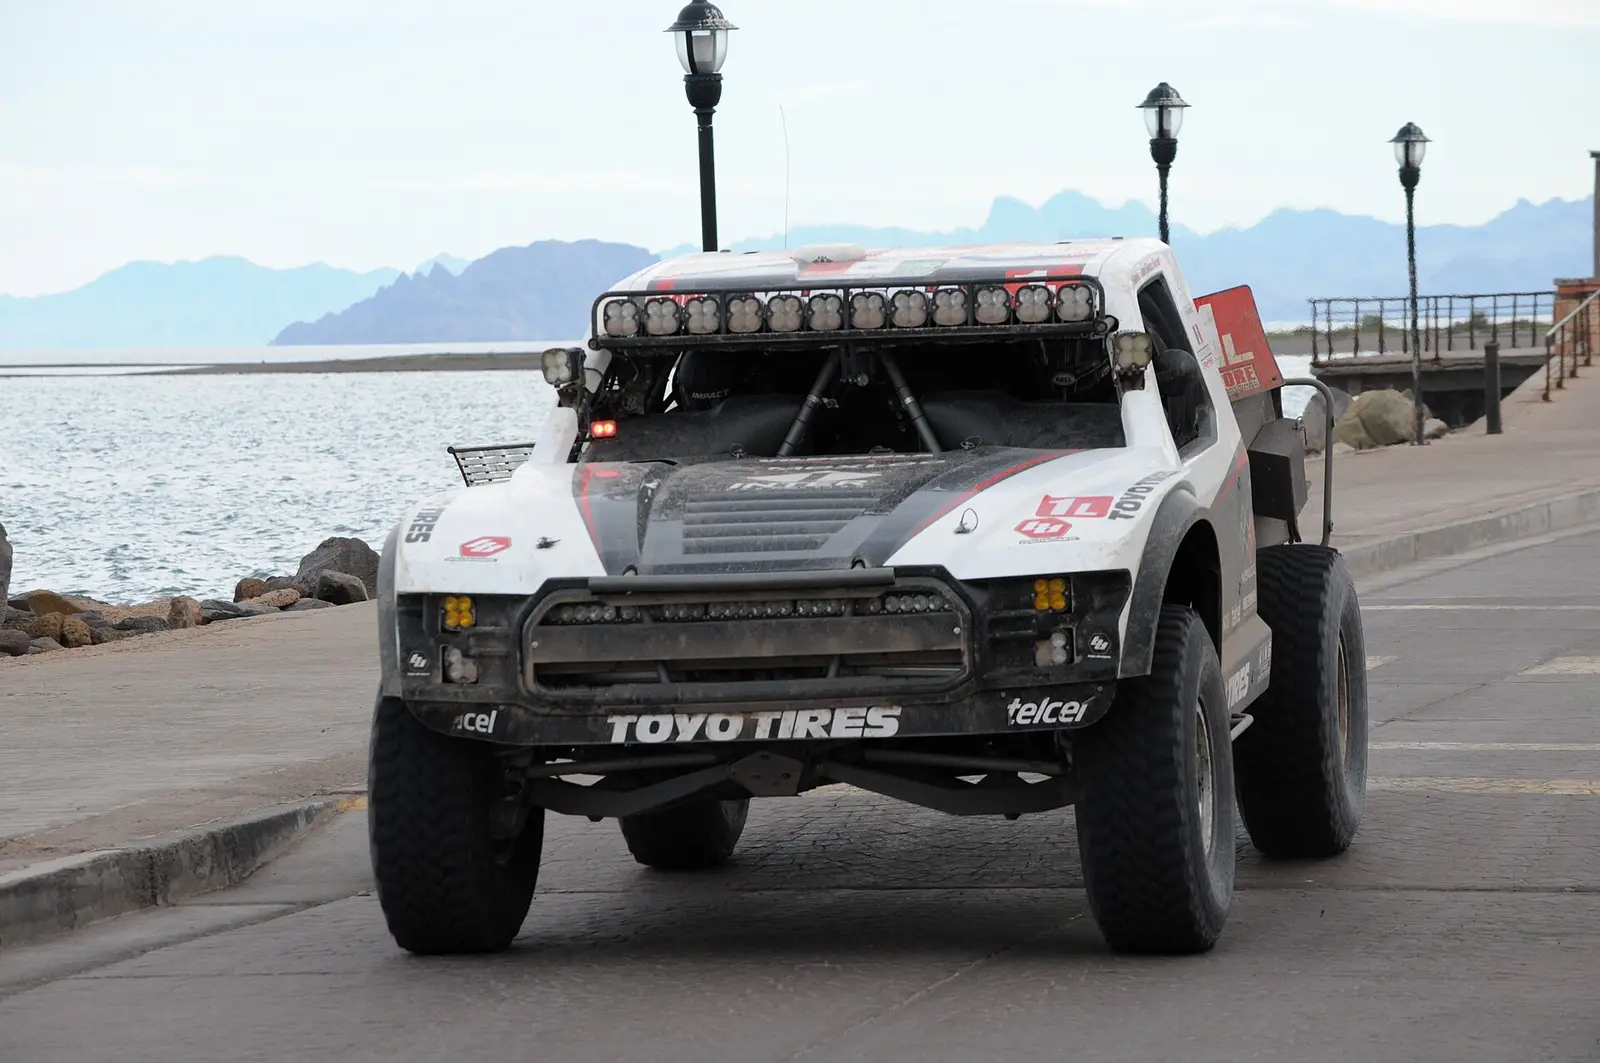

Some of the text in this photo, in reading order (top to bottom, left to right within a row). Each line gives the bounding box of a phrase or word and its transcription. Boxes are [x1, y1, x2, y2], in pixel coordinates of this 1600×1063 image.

[692, 388, 730, 399] IMPACT
[1108, 485, 1155, 520] TOYO
[606, 705, 902, 744] TOYO TIRES
